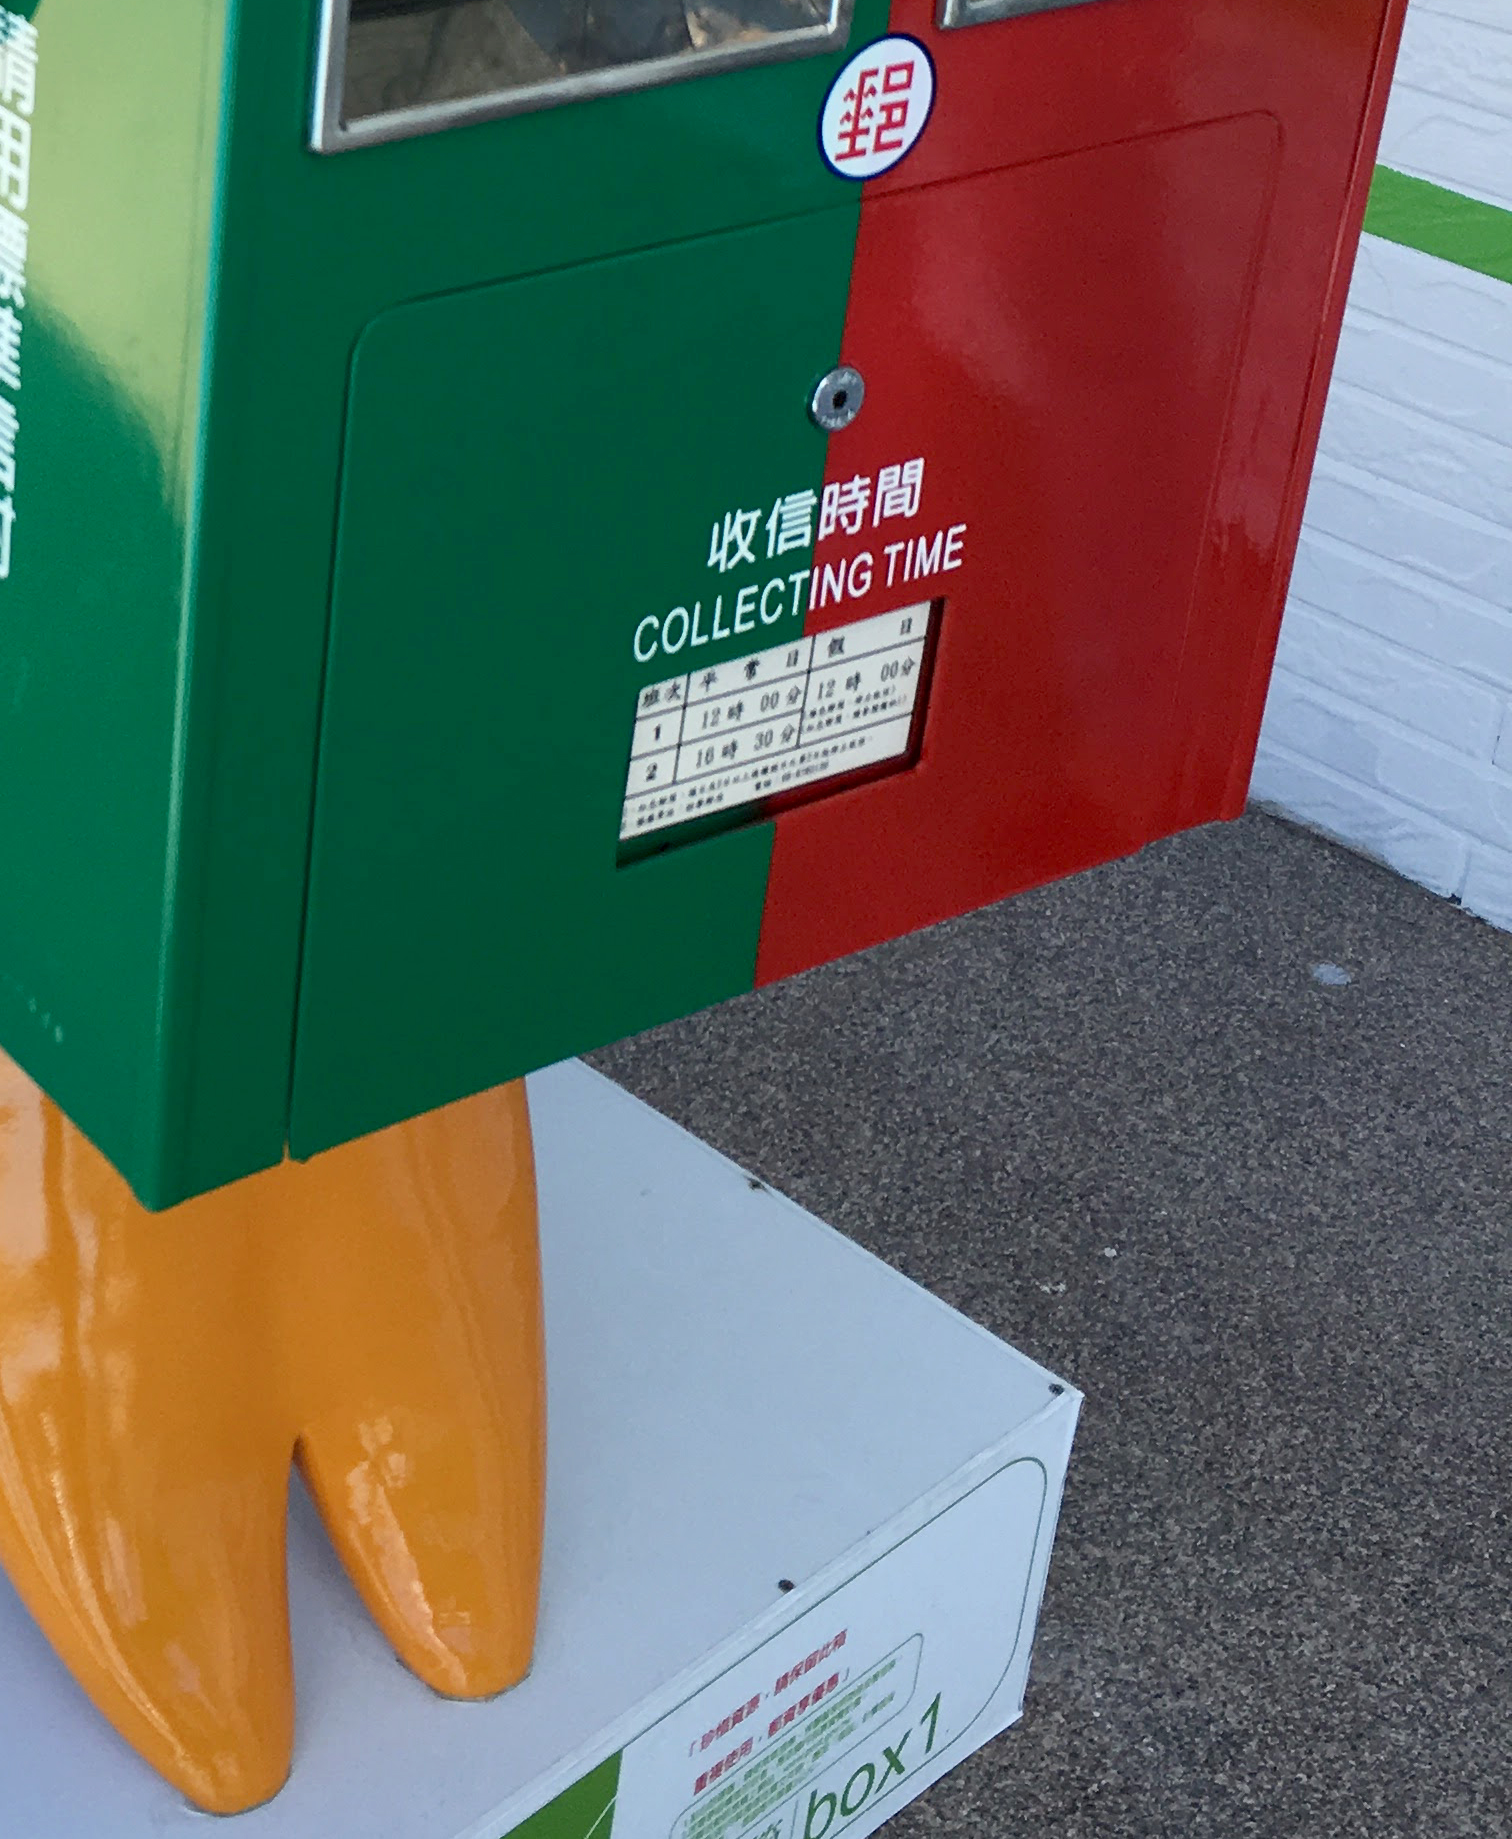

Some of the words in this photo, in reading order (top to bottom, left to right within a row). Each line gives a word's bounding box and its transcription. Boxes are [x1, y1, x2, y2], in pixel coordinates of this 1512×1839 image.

[835, 60, 915, 161] 郵
[707, 457, 925, 573] 收信時間
[634, 552, 874, 662] COLLECTING
[884, 523, 967, 588] TIME
[646, 762, 658, 782] 2
[653, 723, 662, 741] 1
